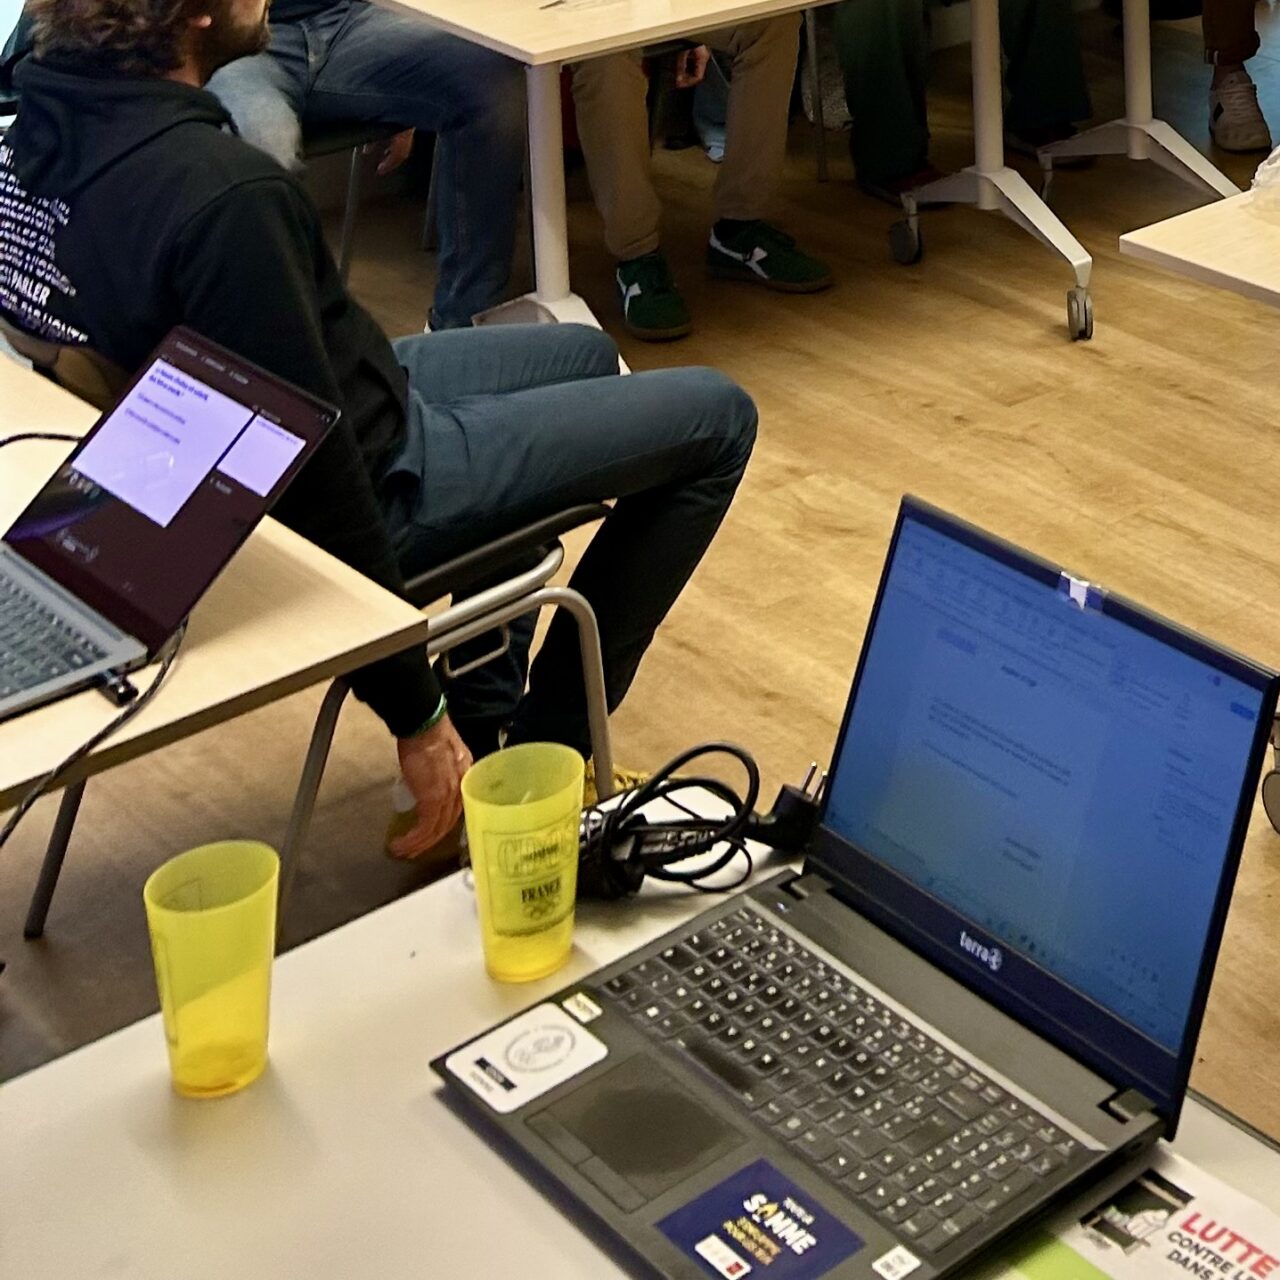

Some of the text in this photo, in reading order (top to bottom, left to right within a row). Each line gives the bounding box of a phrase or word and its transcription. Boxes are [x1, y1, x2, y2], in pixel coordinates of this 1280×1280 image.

[960, 931, 989, 962] terra
[1166, 1249, 1214, 1280] DANS
[1167, 1231, 1234, 1274] CONTRE
[1181, 1213, 1280, 1279] LUTTE
